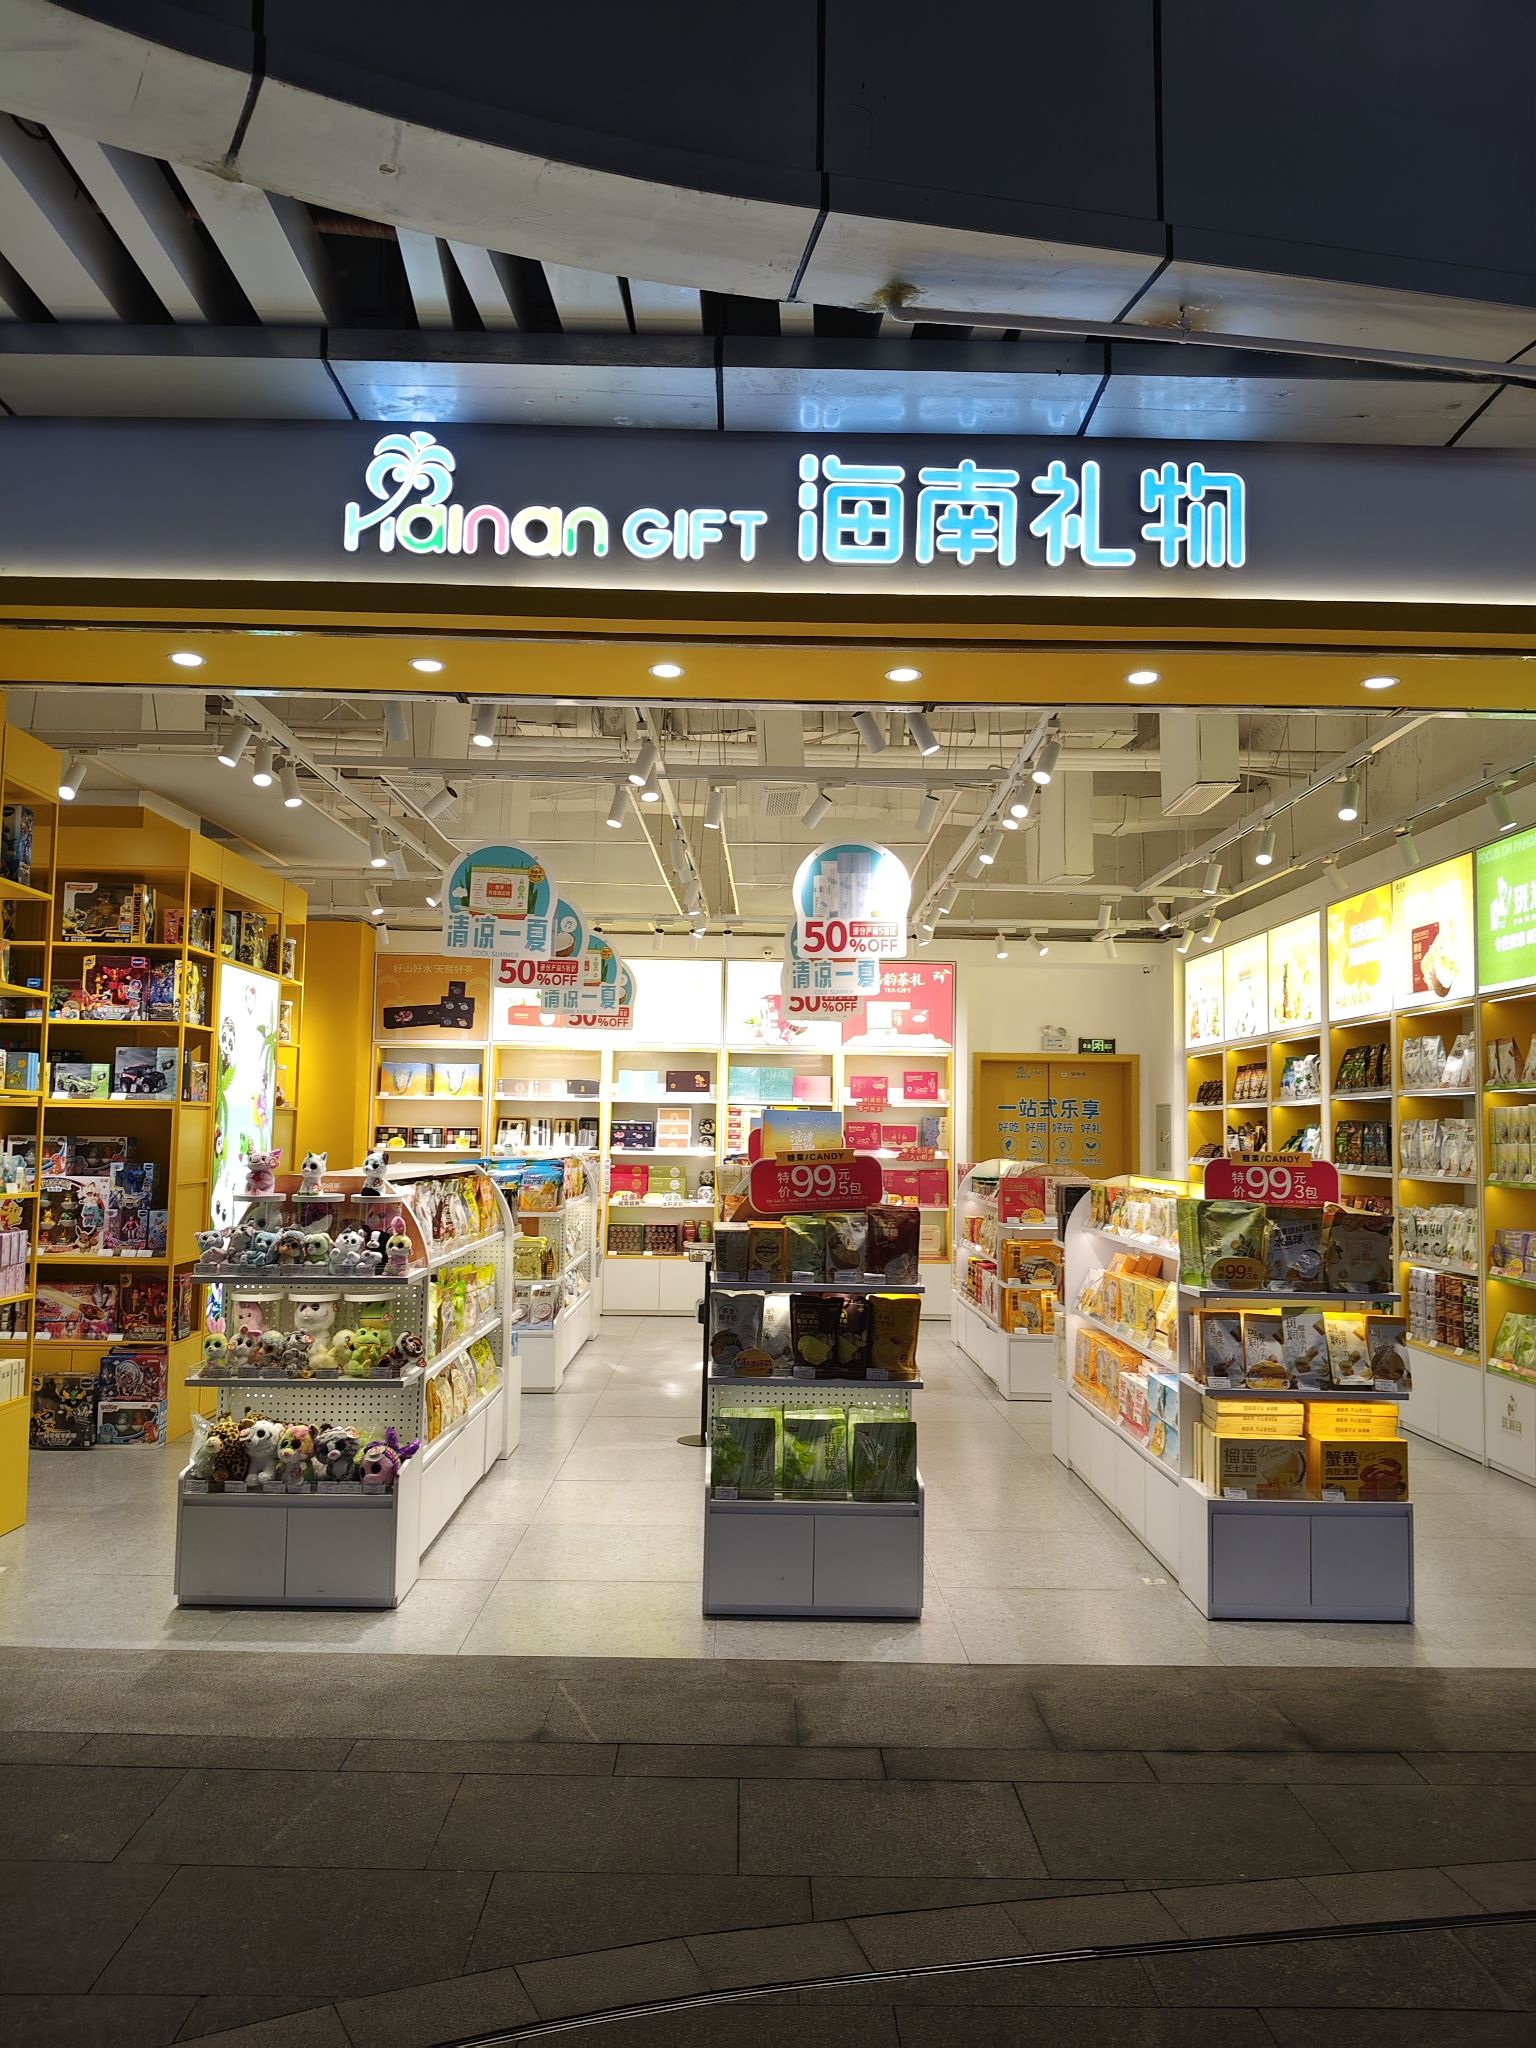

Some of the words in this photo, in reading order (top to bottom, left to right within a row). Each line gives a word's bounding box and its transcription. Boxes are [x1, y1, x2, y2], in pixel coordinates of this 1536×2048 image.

[343, 466, 609, 557] Hainan
[622, 507, 768, 562] GIFT
[797, 453, 1247, 570] 海南礼物
[133, 892, 142, 936] TRANSFORMERS
[447, 914, 549, 953] 清凉一夏
[803, 921, 848, 953] 50
[849, 938, 898, 954] %OFF
[393, 963, 432, 974] 好山好水
[435, 964, 474, 975] 天赋好茶
[498, 959, 536, 985] 50
[792, 960, 876, 989] 清凉一夏
[537, 974, 578, 986] %OFF
[822, 1002, 858, 1012] %OFF
[598, 1018, 629, 1027] %OFF
[998, 1099, 1100, 1119] 一站式乐享
[998, 1123, 1020, 1133] 好吃
[1025, 1123, 1047, 1133] 好用
[1052, 1123, 1074, 1134] 好玩
[1080, 1124, 1102, 1134] 好礼
[791, 1165, 836, 1197] 99
[838, 1168, 851, 1180] 元
[1294, 1172, 1307, 1184] 元
[777, 1171, 791, 1198] 特价
[839, 1182, 862, 1195] 5包
[1232, 1171, 1246, 1198] 特价
[1246, 1167, 1292, 1199] 99
[1295, 1185, 1318, 1199] 3包
[1274, 1234, 1304, 1247] 水晶球
[1225, 1264, 1247, 1279] 99
[1224, 1448, 1257, 1464] 榴莲
[1325, 1450, 1358, 1467] 蟹黄
[1224, 1464, 1257, 1473] 芝士薄饼
[1325, 1467, 1358, 1477] 肉松薄饼
